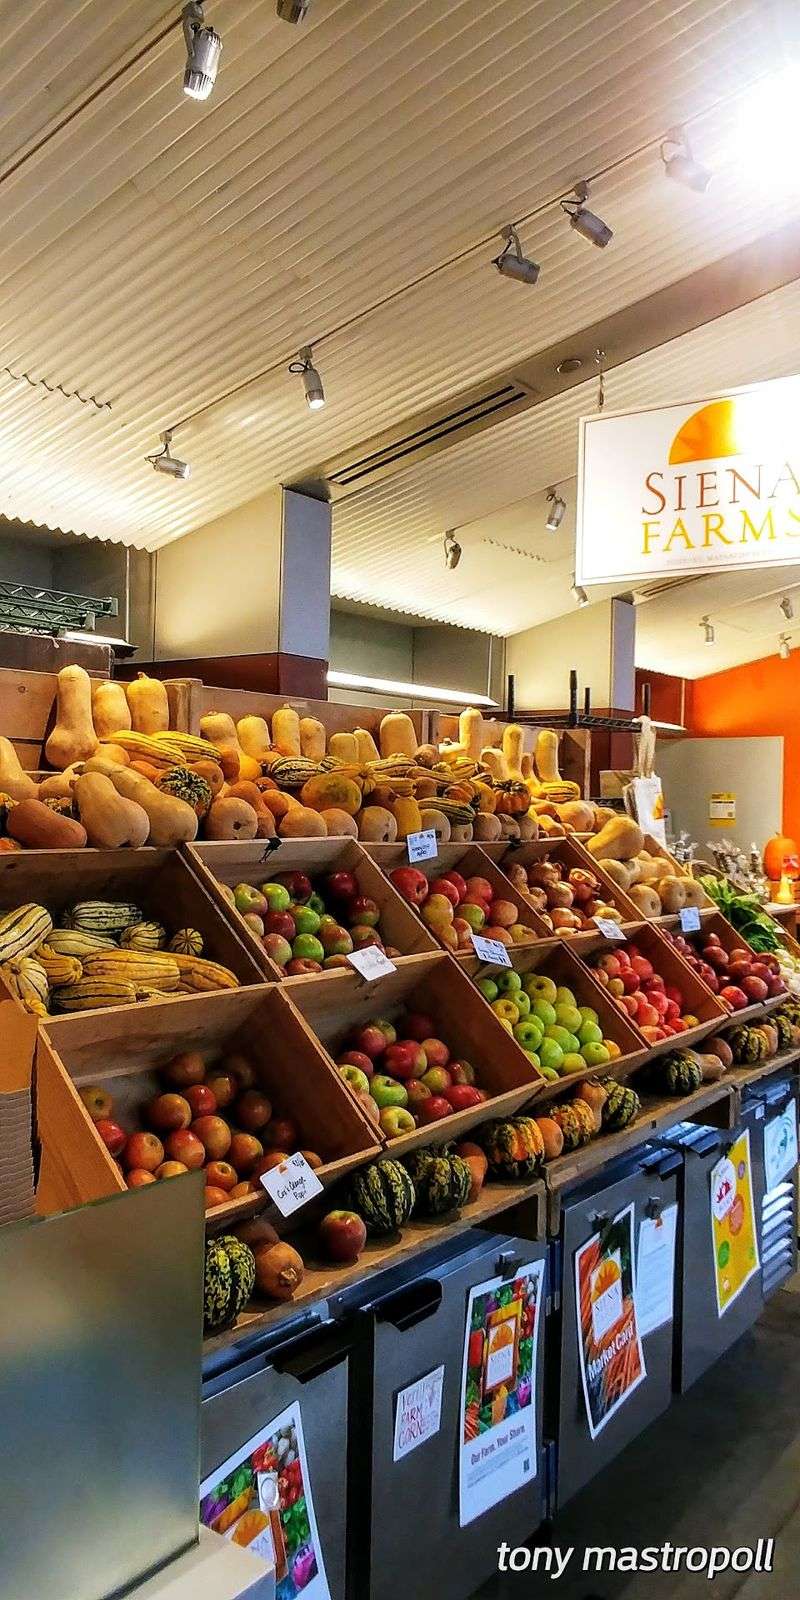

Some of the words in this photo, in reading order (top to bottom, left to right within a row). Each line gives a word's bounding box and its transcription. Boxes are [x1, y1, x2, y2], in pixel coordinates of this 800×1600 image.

[641, 461, 800, 516] SIENA
[641, 507, 800, 555] FARMS
[587, 1340, 616, 1382] Market
[615, 1320, 634, 1350] Card
[470, 1451, 481, 1466] Our
[496, 1433, 509, 1449] Your
